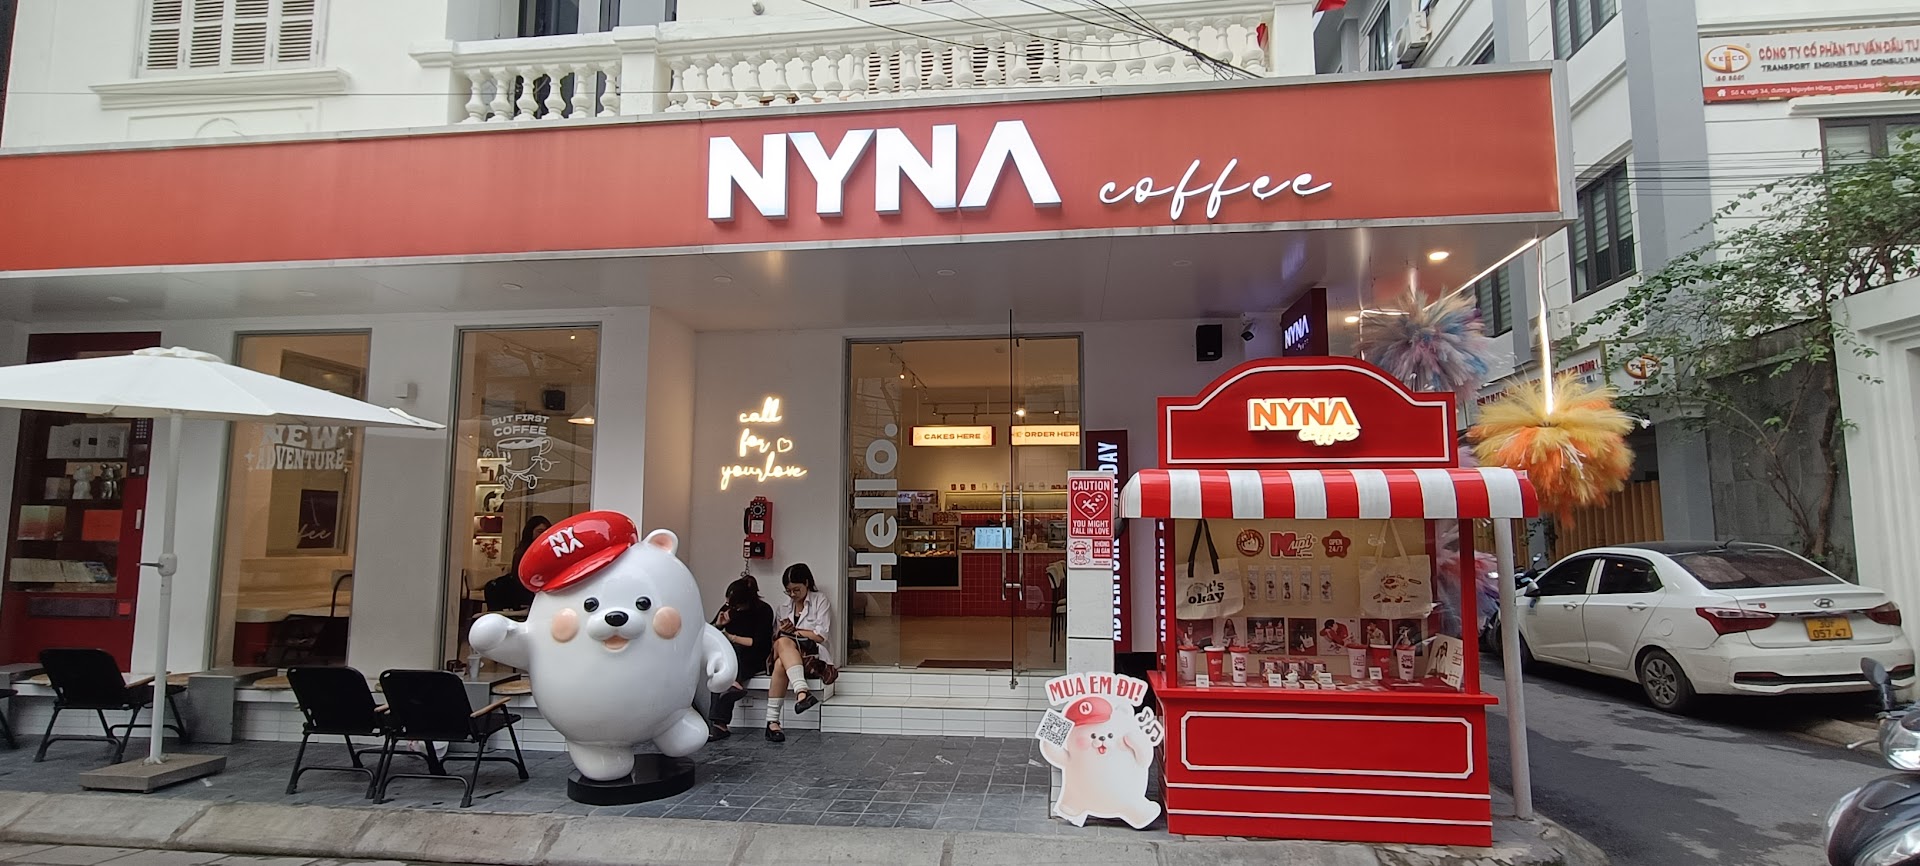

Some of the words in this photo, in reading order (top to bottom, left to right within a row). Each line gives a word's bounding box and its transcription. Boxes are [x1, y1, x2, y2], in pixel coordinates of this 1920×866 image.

[1788, 46, 1802, 59] TY
[1761, 62, 1811, 72] TRANSPORT
[1814, 59, 1868, 69] ENGINEERING
[707, 119, 1062, 222] NYNA
[1099, 158, 1333, 221] coffee
[1284, 315, 1309, 350] NYNA
[739, 396, 782, 423] call
[1252, 400, 1355, 427] NYNA
[491, 414, 514, 426] BUT
[515, 413, 550, 424] FIRST
[262, 424, 340, 450] NEW
[493, 425, 548, 437] COFFEE
[739, 428, 770, 457] for
[255, 444, 345, 470] ADVENTURE
[1071, 480, 1110, 491] CAUTION
[854, 423, 898, 592] Hello.
[1072, 519, 1086, 528] YOU
[1087, 519, 1109, 528] MIGHT
[1072, 527, 1086, 535] FALL
[1086, 527, 1094, 535] IN
[1094, 527, 1110, 535] LOVE
[1328, 538, 1343, 546] OPEN
[1328, 545, 1343, 553] 24/7
[1188, 592, 1225, 605] okay
[1048, 677, 1086, 702] MUA
[1089, 676, 1112, 695] EM
[1116, 679, 1144, 702] ĐI!
[1080, 703, 1090, 713] N
